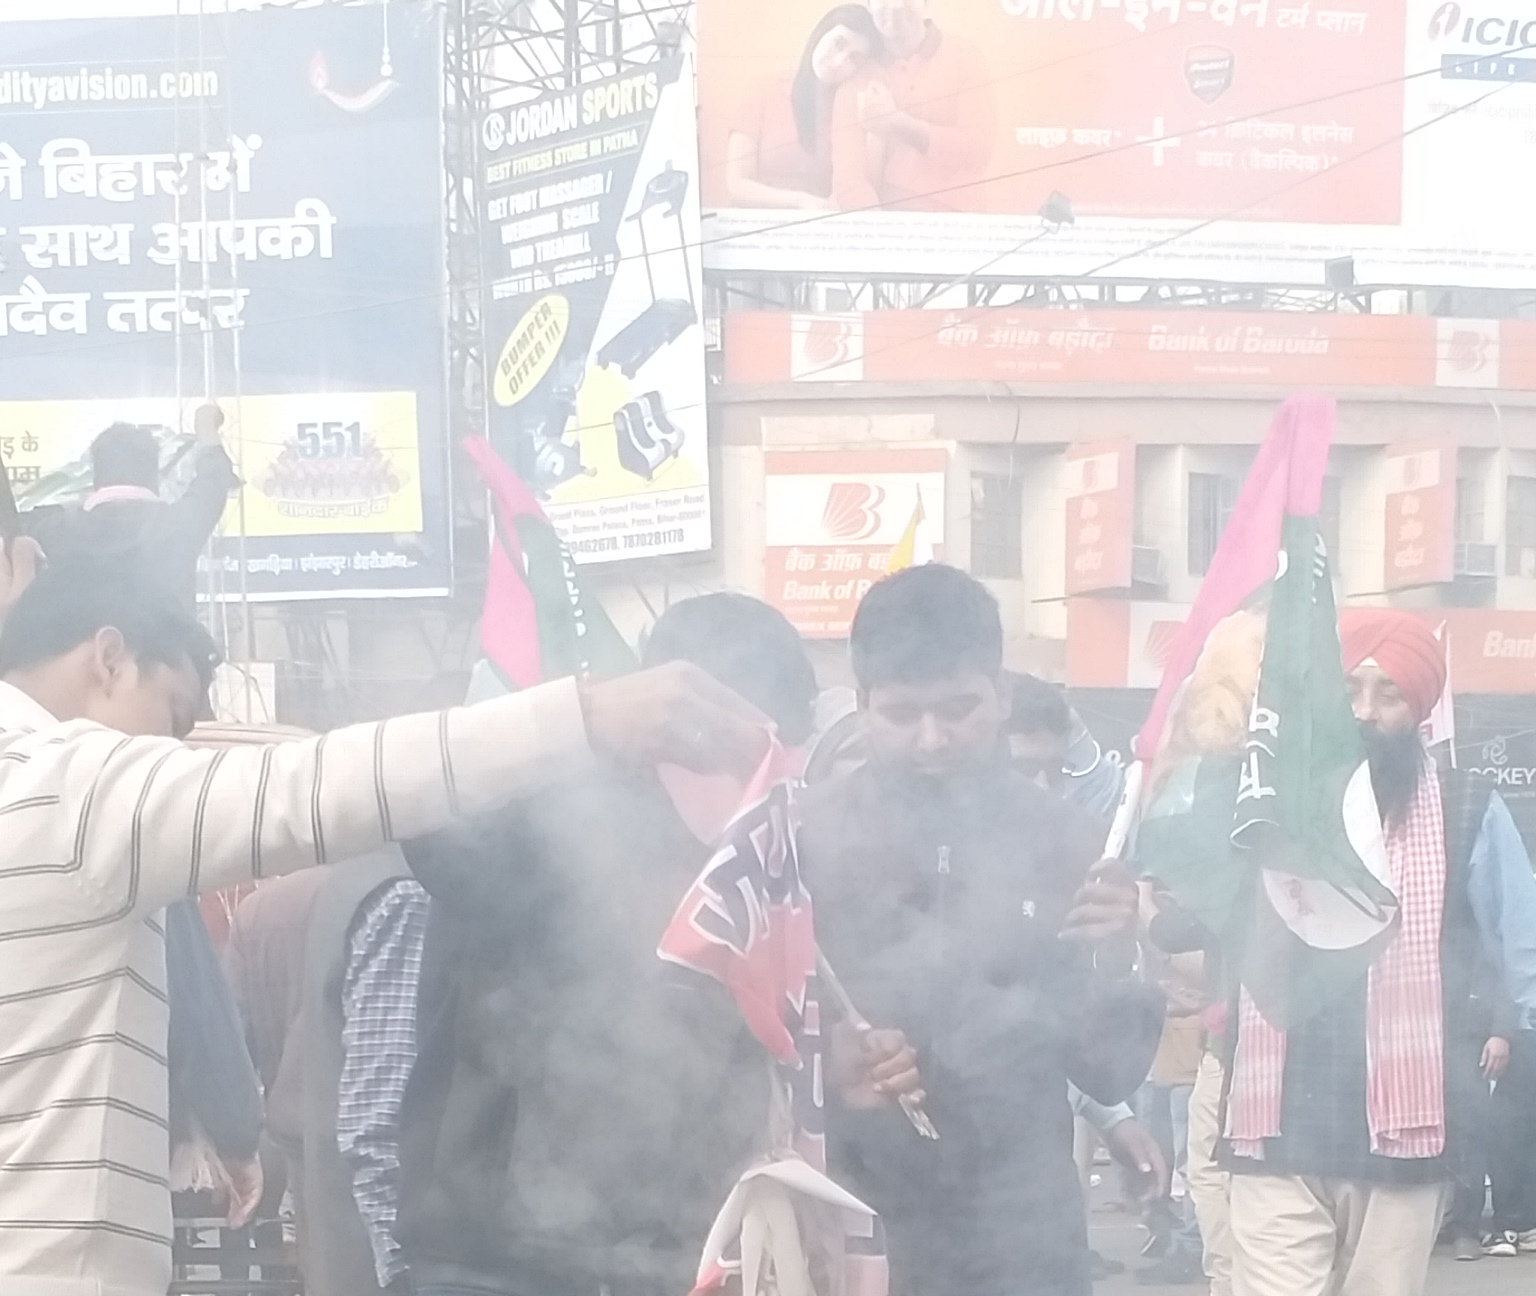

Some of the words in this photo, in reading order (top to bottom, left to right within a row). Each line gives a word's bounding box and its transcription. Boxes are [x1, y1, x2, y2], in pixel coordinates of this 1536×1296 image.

[1454, 61, 1516, 76] LIFE
[506, 94, 578, 146] JORDAN
[582, 72, 658, 126] SPORTS
[39, 137, 193, 203] बिहार
[487, 160, 511, 185] BEST
[512, 151, 553, 177] FITNESS
[554, 141, 589, 167] STORE
[603, 128, 639, 153] PATNA
[19, 220, 135, 270] साथ
[146, 197, 339, 264] आपकी
[501, 302, 554, 377] BUMPER
[1148, 325, 1210, 352] Bank
[1242, 325, 1330, 355] Baroda
[508, 343, 546, 395] OFFER
[21, 431, 40, 455] के
[297, 421, 361, 459] 551
[784, 547, 817, 573] बैंक
[783, 580, 833, 600] Bank
[834, 579, 855, 600] of
